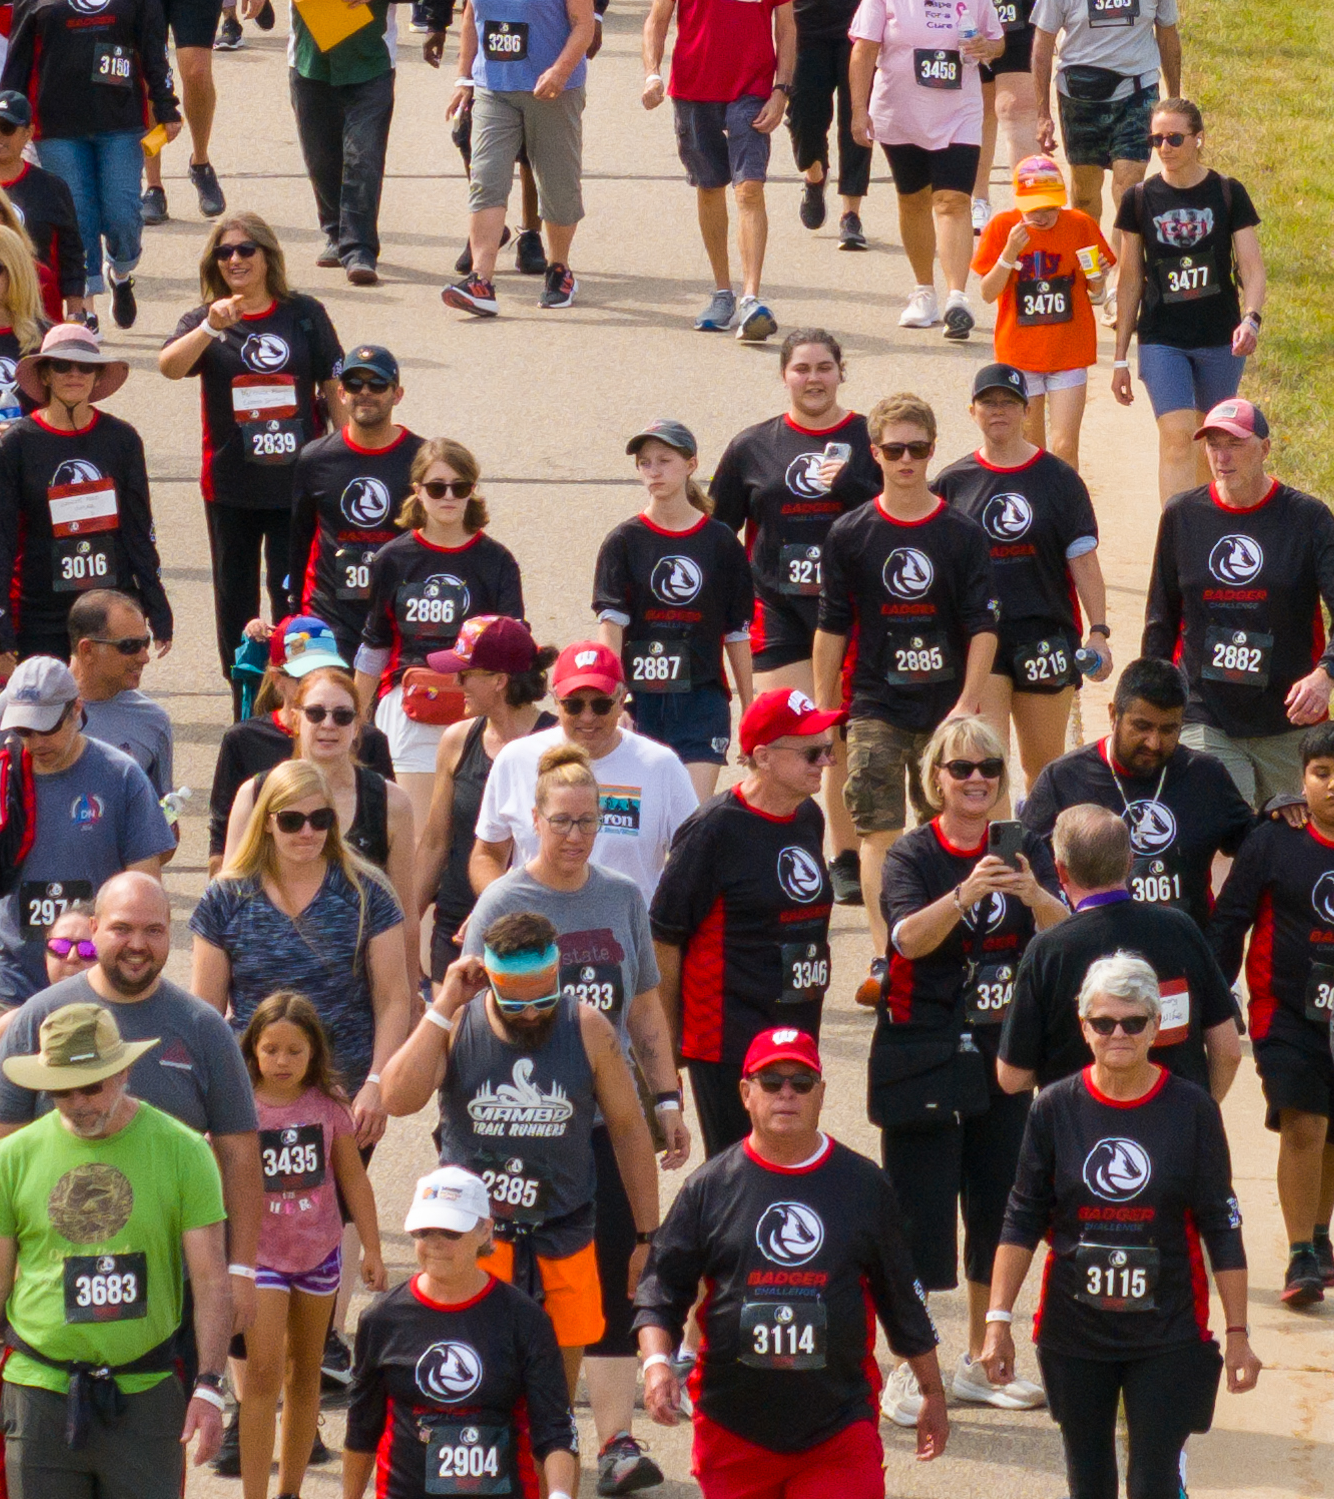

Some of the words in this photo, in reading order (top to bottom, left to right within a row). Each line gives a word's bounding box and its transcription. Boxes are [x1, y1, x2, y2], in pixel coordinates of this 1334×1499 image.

[926, 22, 953, 30] Cure
[488, 33, 521, 52] 3286
[920, 60, 957, 80] 3458
[1168, 267, 1209, 292] 3477
[1023, 292, 1066, 315] 3476
[253, 432, 296, 455] 2839
[61, 553, 108, 579] 3016
[346, 565, 370, 589] 30
[789, 559, 822, 584] 321
[1202, 589, 1267, 601] BADGER
[405, 598, 454, 623] 2886
[575, 650, 597, 669] W
[633, 655, 681, 680] 2887
[895, 647, 943, 672] 2885
[1024, 650, 1067, 682] 3215
[1212, 643, 1262, 673] 2882
[1132, 875, 1181, 901] 3061
[29, 899, 80, 926] 297
[562, 947, 610, 964] state
[792, 960, 828, 989] 3346
[977, 984, 1014, 1010] 334
[772, 1030, 799, 1047] W
[472, 1121, 506, 1137] TRAIL
[509, 1121, 567, 1137] RUNNERS
[262, 1143, 319, 1176] 3435
[483, 1170, 540, 1208] 2385
[1078, 1206, 1155, 1222] BADGER
[76, 1273, 137, 1307] 3683
[747, 1269, 828, 1286] BADGER
[1086, 1264, 1148, 1299] 3115
[755, 1287, 817, 1297] CHALLENGE
[753, 1324, 815, 1355] 3114
[438, 1445, 499, 1478] 2904
